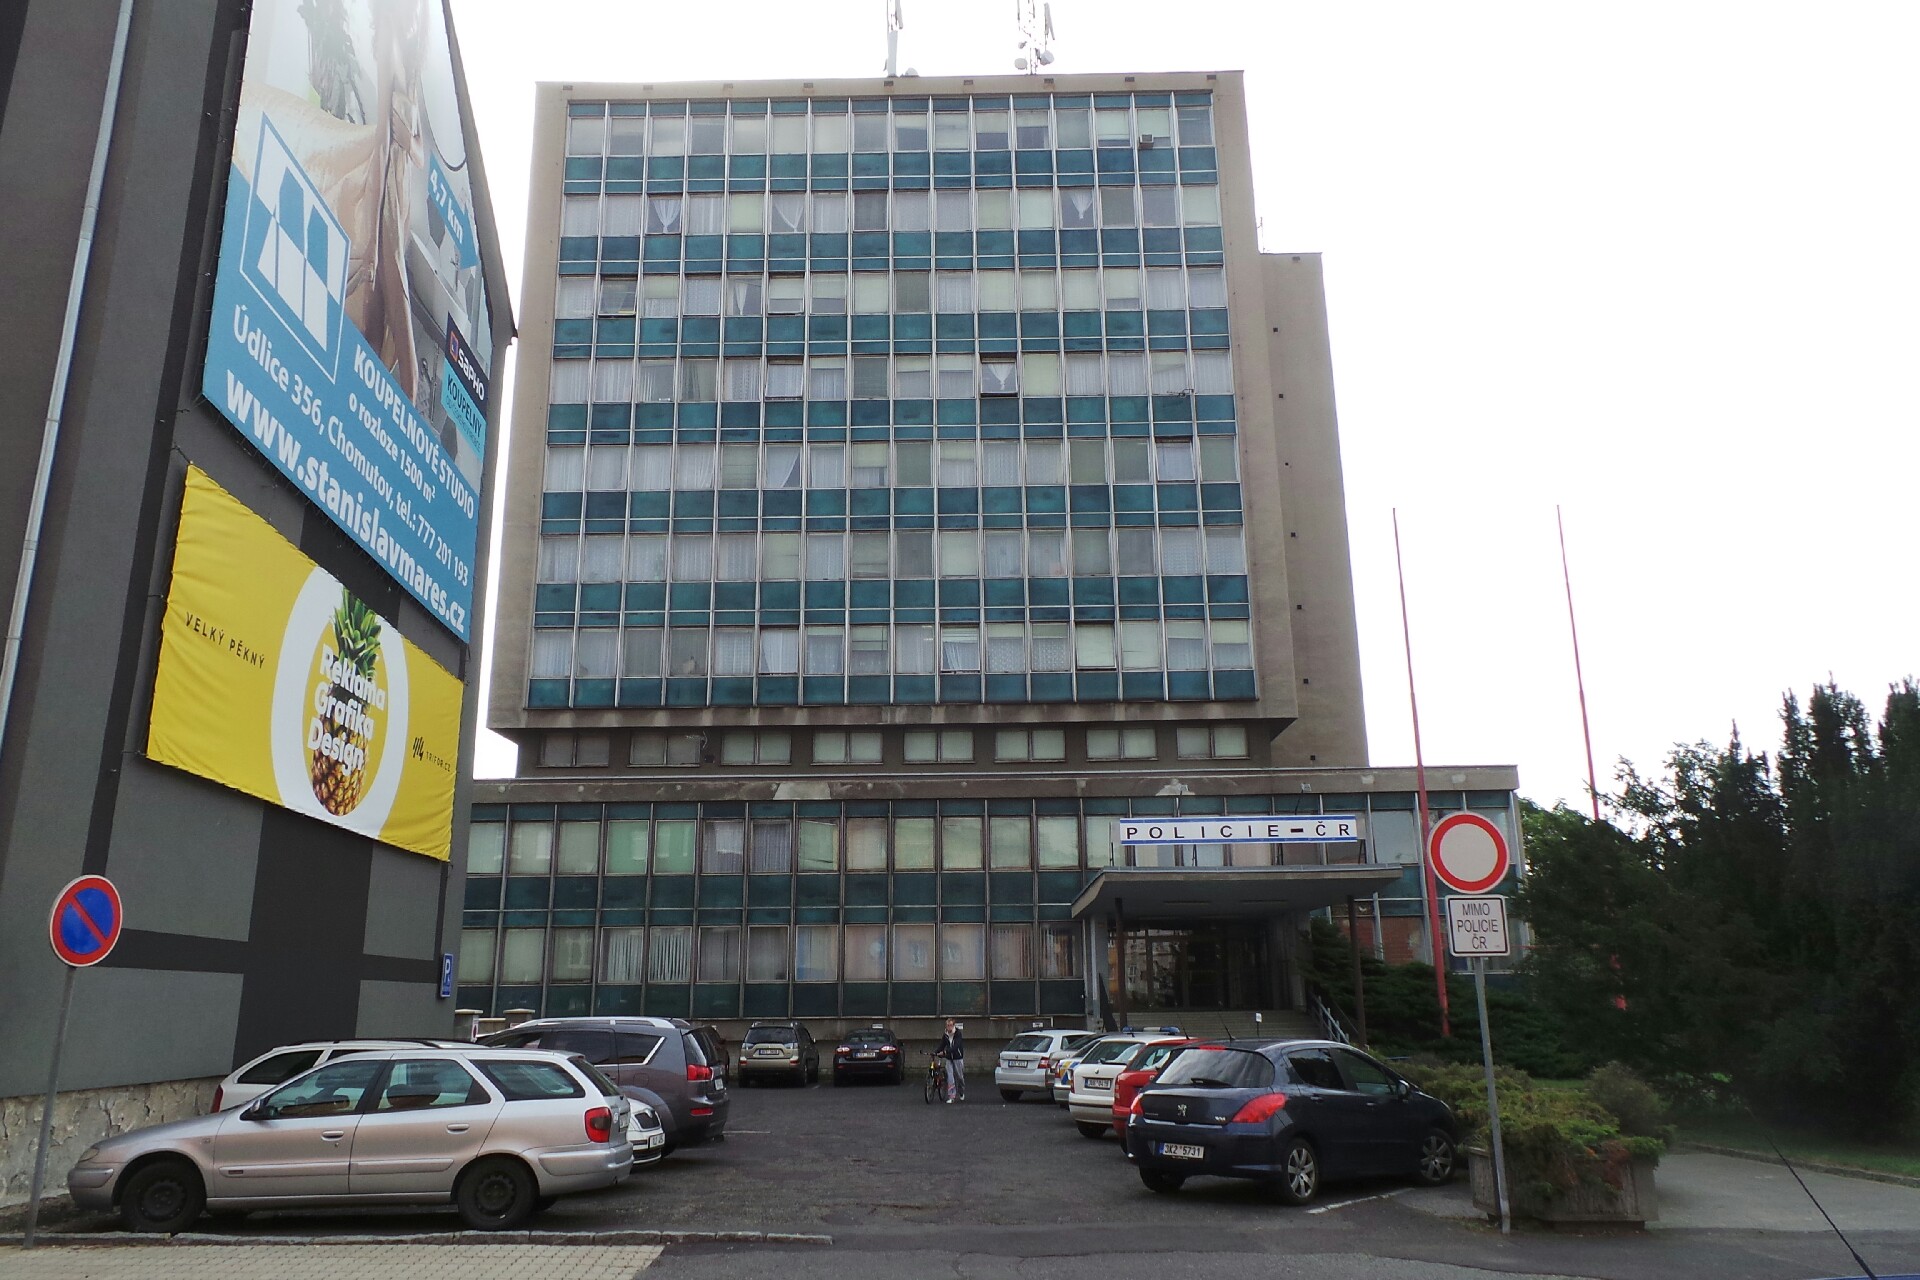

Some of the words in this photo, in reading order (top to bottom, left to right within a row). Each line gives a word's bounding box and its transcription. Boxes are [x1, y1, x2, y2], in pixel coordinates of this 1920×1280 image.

[430, 168, 447, 208] 4,7
[447, 197, 463, 245] km
[354, 343, 440, 475] KOUPELNOVÉ
[438, 458, 475, 520] STUDIO
[447, 373, 482, 438] KOUPELNY
[233, 304, 290, 392] Údlice
[290, 373, 325, 436] 356,
[327, 415, 395, 510] Chomutov,
[396, 491, 417, 532] tel.:
[417, 513, 436, 550] 777
[435, 536, 451, 570] 201
[454, 555, 469, 587] 193
[349, 392, 358, 412] o
[358, 403, 399, 463] rozloze
[399, 448, 424, 491] 1500
[227, 368, 466, 635] www.stanislavmares.cz
[186, 611, 225, 646] VELKÝ
[319, 643, 386, 711] Reklama
[314, 680, 375, 740] Grafika
[307, 716, 365, 777] Design
[1456, 919, 1499, 932] POLICIE
[1462, 902, 1490, 916] MIMO
[1471, 933, 1488, 950] ČR
[1164, 1142, 1178, 1155] 3K2
[1182, 1145, 1201, 1157] 5731
